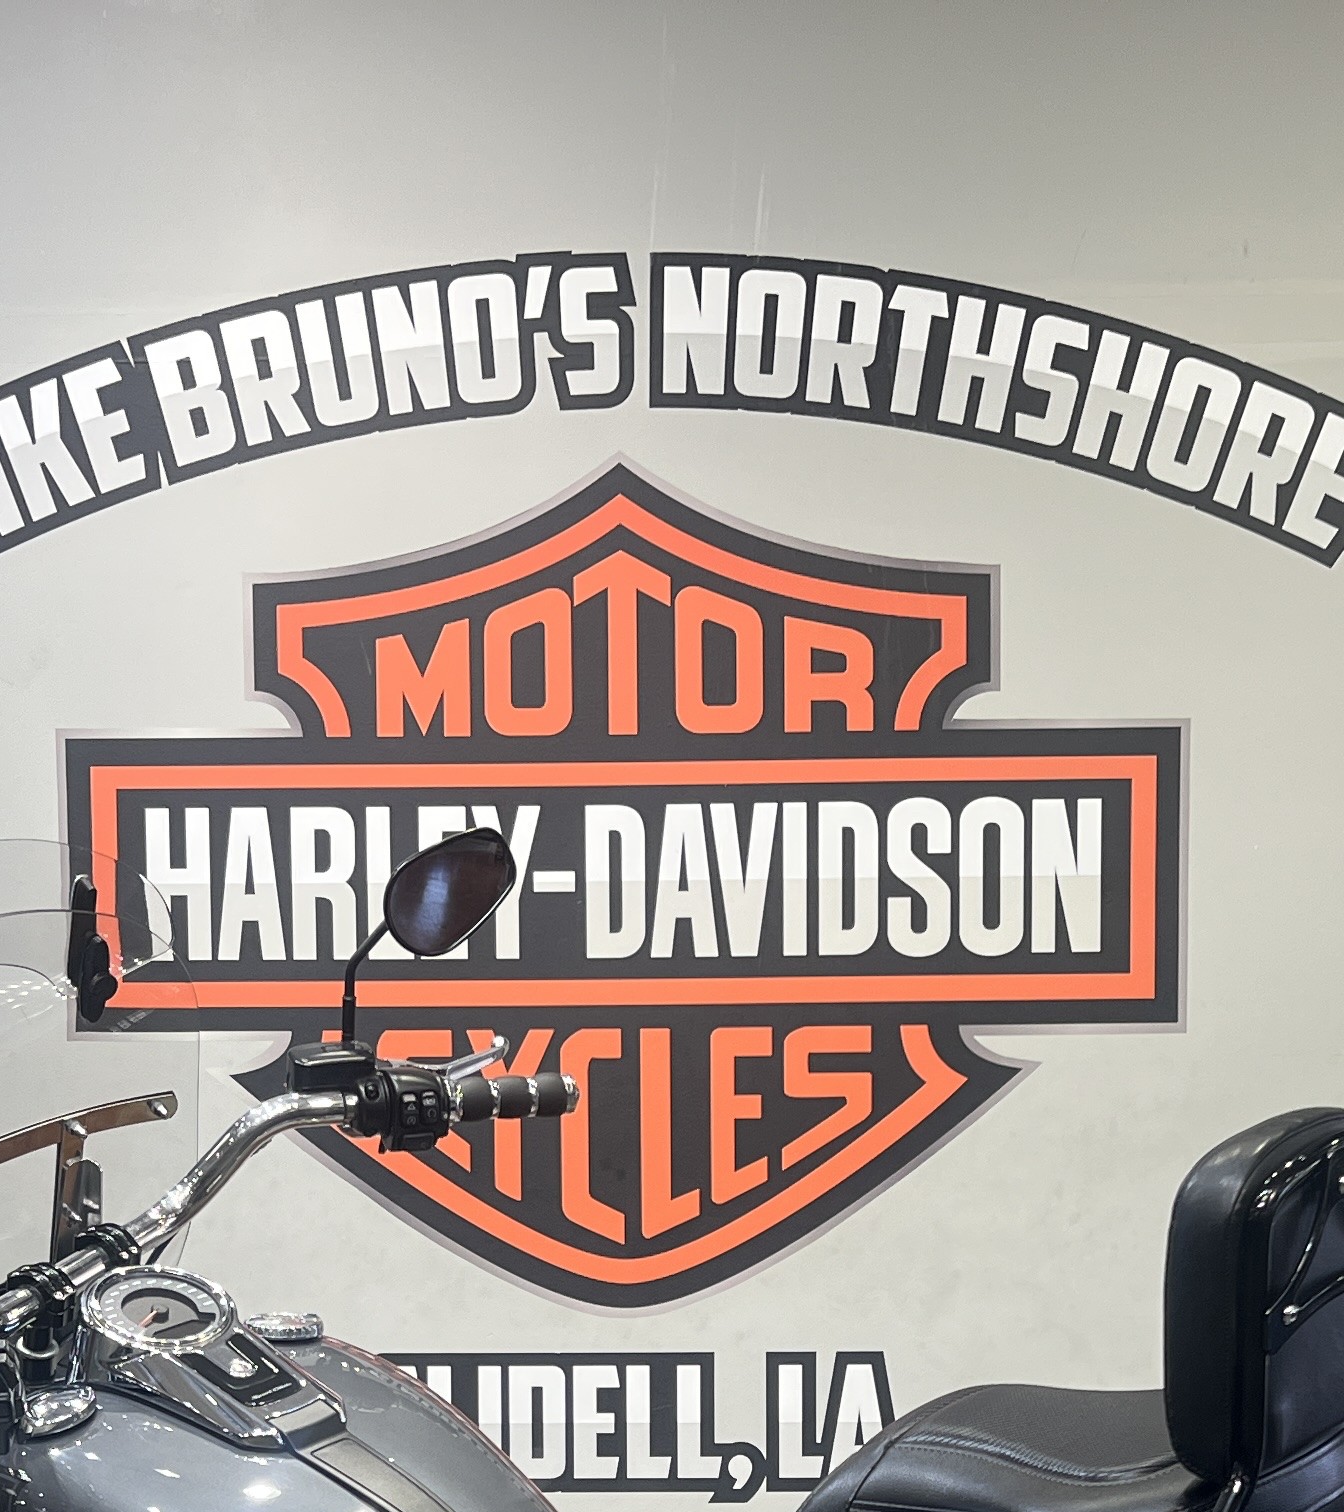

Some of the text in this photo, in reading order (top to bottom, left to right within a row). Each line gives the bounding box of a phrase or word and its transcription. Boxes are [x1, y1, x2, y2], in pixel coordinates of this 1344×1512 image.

[144, 265, 621, 468] BRUNO'S
[375, 549, 875, 738] MOTOR
[396, 1363, 753, 1490] IDELL,
